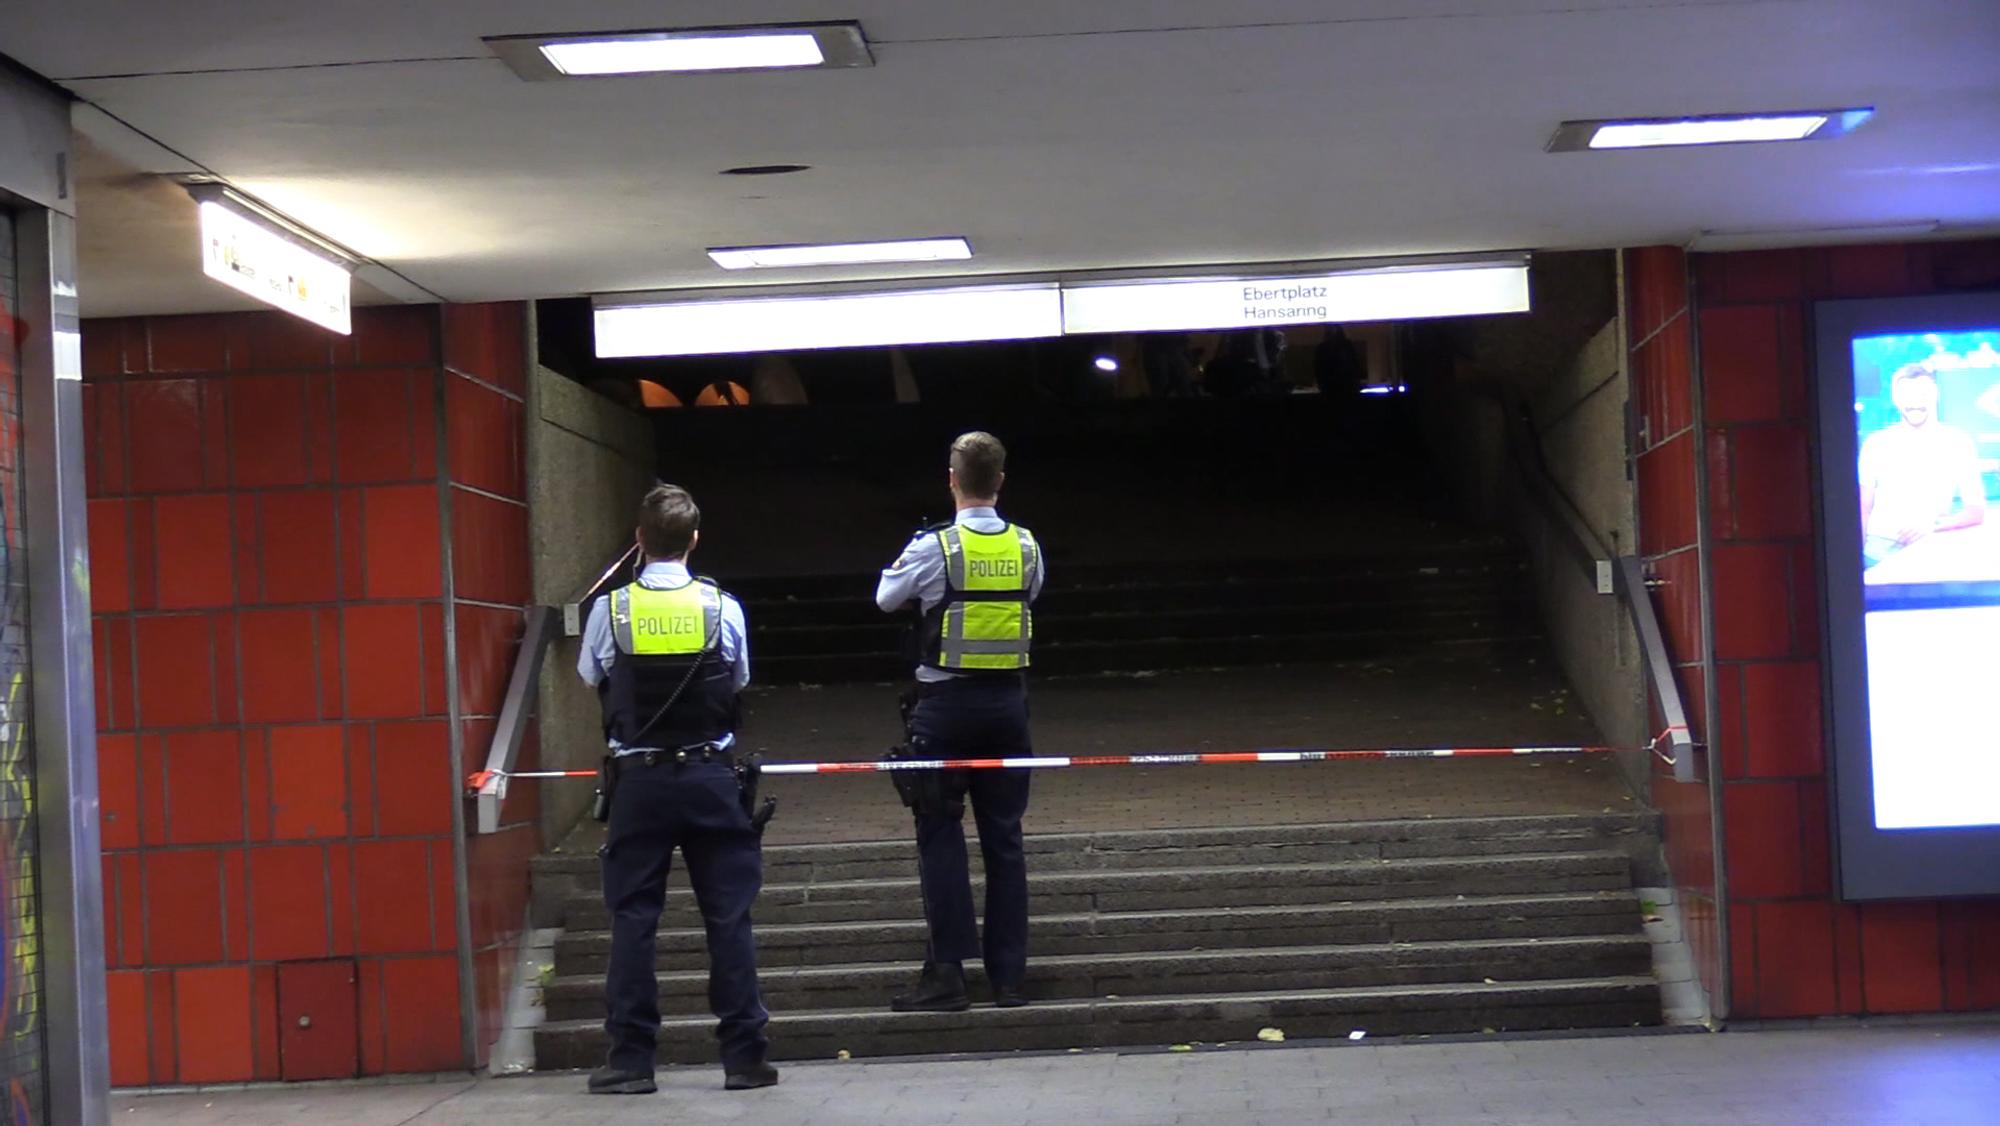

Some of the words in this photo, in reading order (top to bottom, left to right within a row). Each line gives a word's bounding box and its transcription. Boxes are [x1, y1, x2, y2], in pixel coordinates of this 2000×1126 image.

[1243, 285, 1327, 301] Ebertplatz
[1244, 305, 1327, 319] Hansaring
[969, 559, 1018, 577] POLIZEI
[637, 616, 698, 635] POLIZEI
